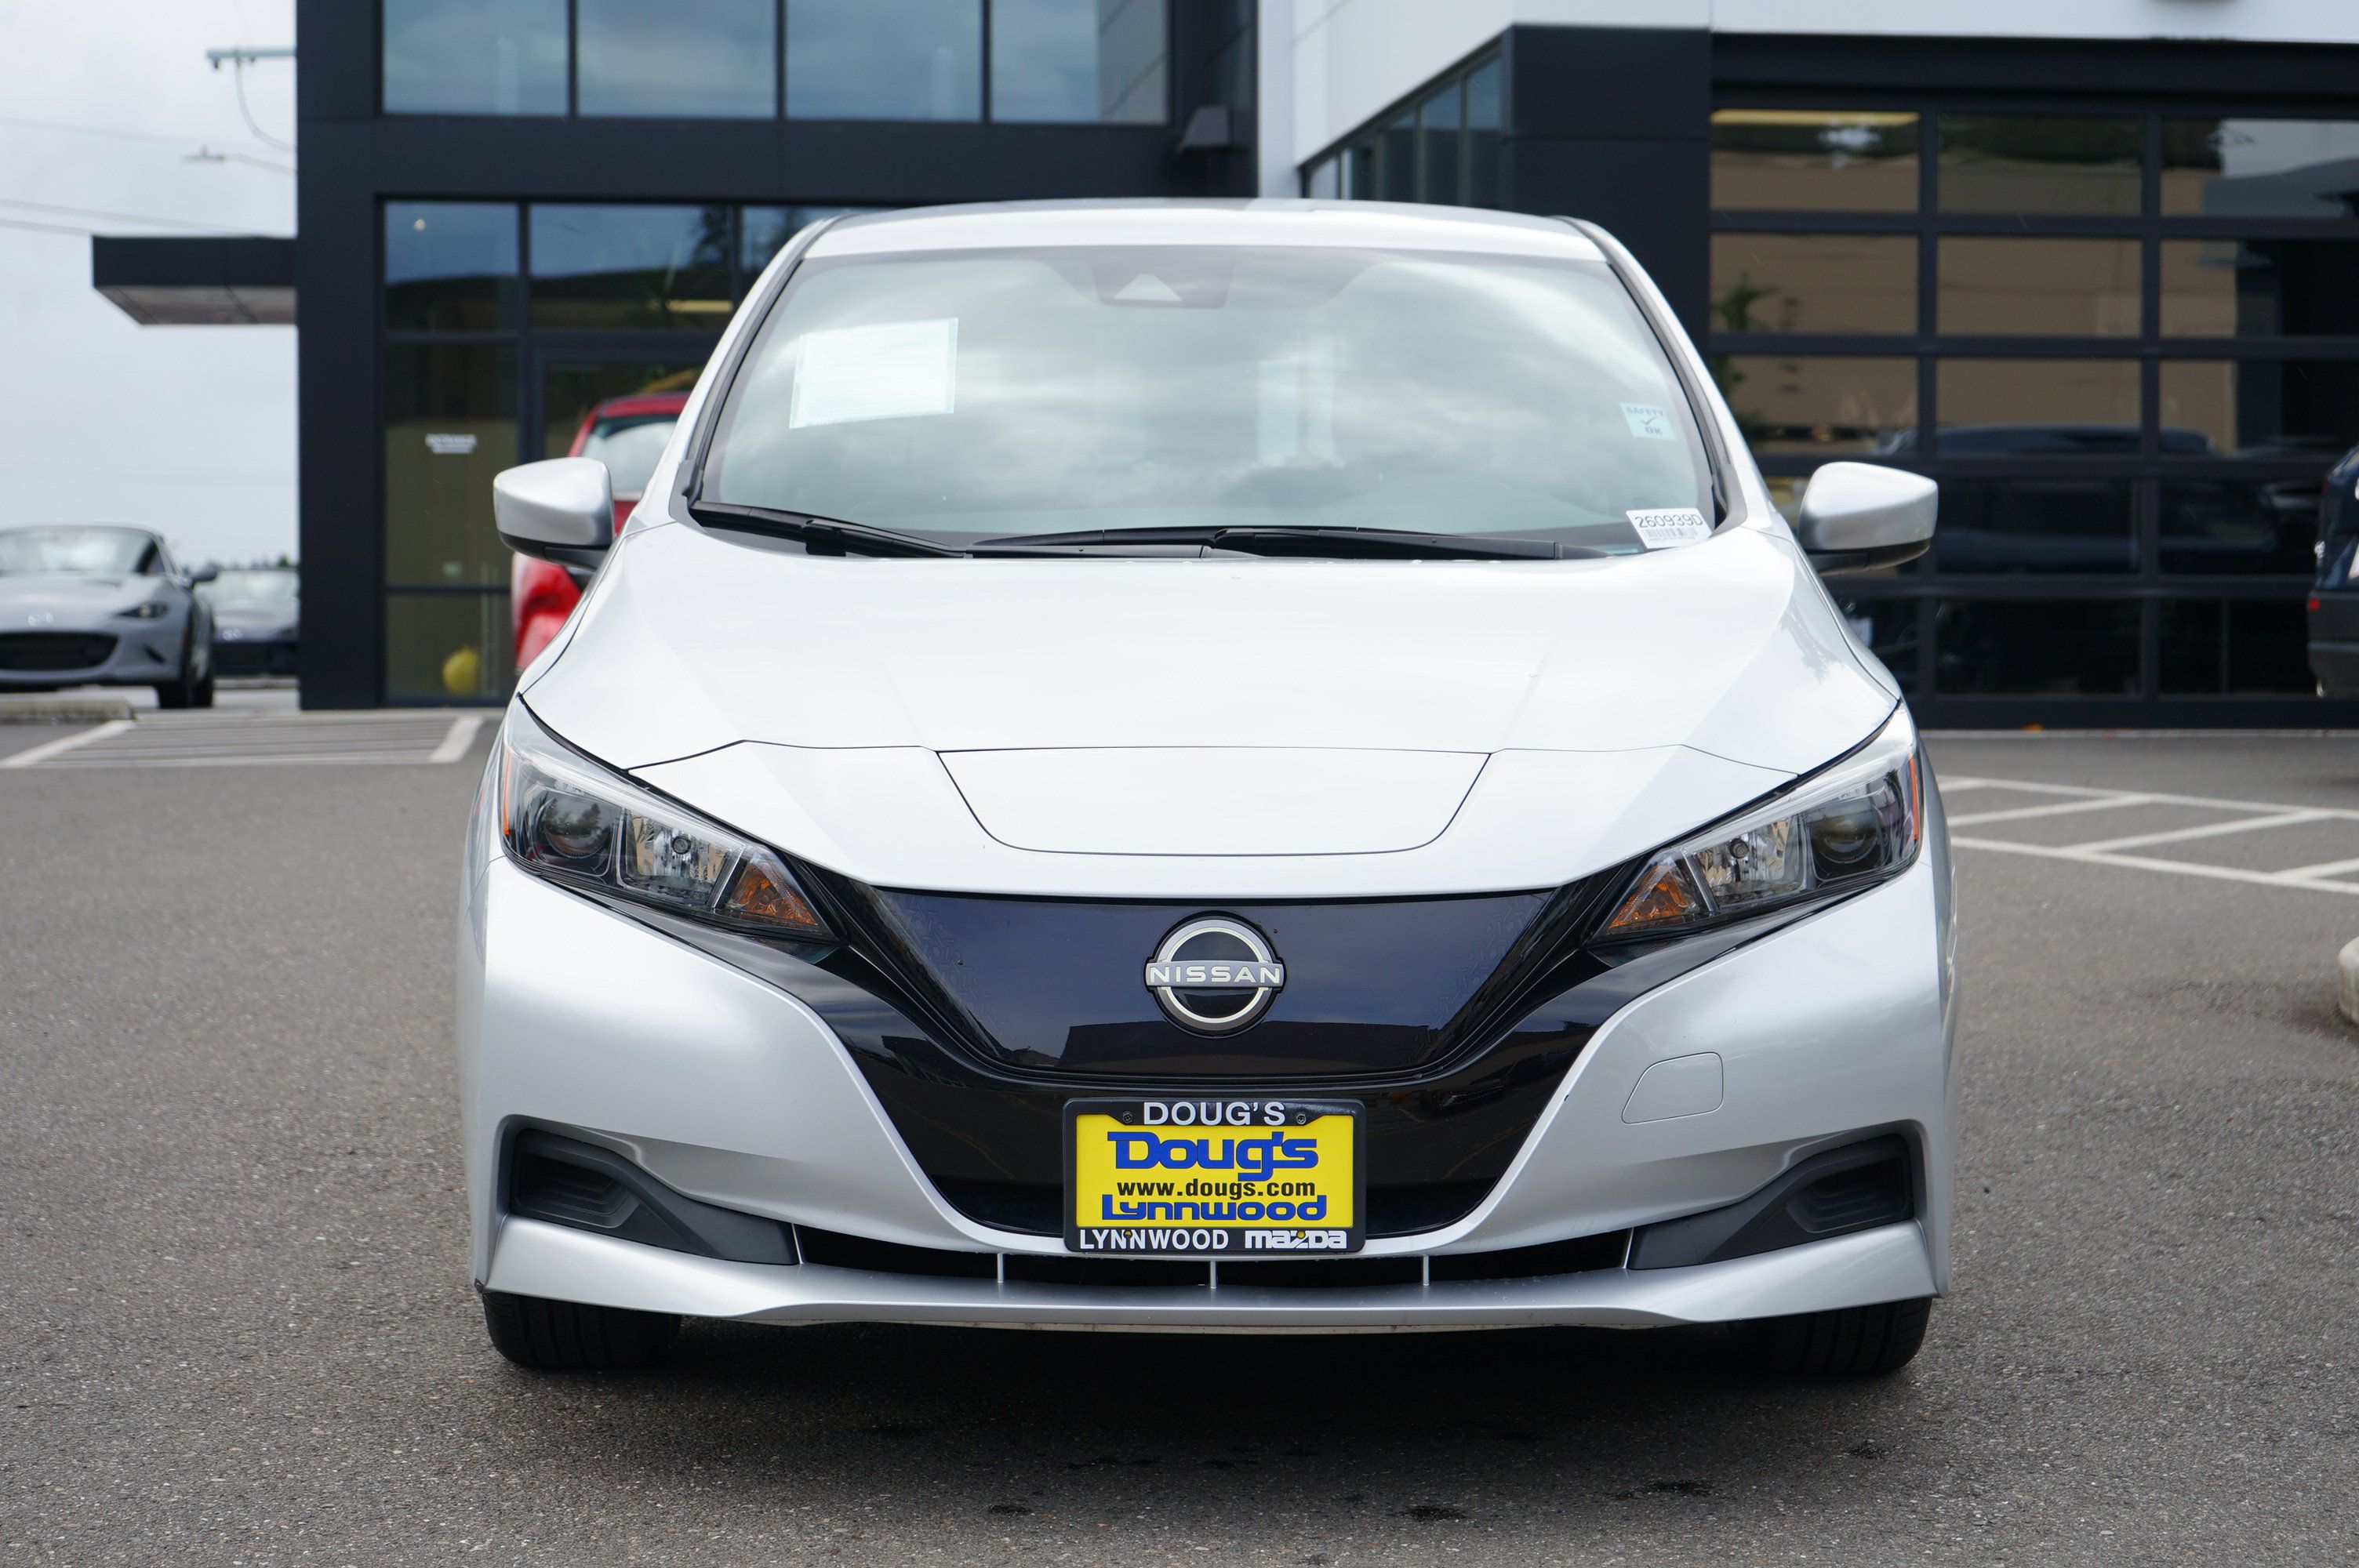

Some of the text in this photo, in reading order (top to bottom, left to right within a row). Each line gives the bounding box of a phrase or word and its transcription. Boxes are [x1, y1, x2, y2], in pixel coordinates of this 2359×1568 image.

[1627, 406, 1663, 417] SAFETY
[1645, 426, 1663, 435] OK
[1150, 966, 1280, 984] NISSAN
[1143, 1102, 1285, 1125] DOUG'S
[1107, 1131, 1319, 1181] Doug's
[1117, 1178, 1315, 1200] www.dougs.com
[1102, 1194, 1327, 1221] Lynnwood
[1080, 1229, 1229, 1250] LYNNWOOD
